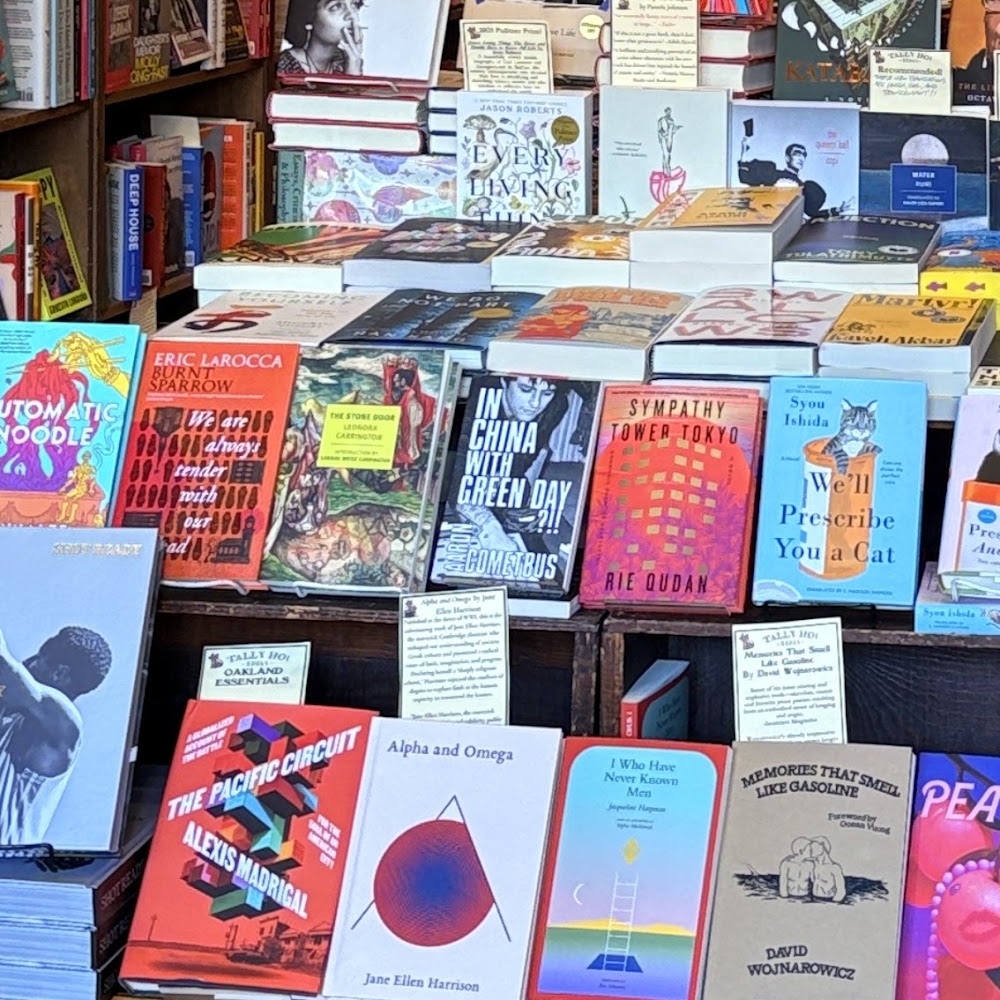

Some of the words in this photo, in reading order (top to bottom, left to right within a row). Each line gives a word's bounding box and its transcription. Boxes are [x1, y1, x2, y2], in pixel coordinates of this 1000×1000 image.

[480, 104, 513, 114] JASON
[516, 105, 562, 115] ROBERTS
[474, 146, 566, 166] EVERY
[912, 171, 936, 179] WATER
[129, 173, 140, 208] DEEP
[470, 178, 572, 199] LIVING
[128, 211, 140, 252] HOUSE
[154, 352, 195, 368] ERIC
[152, 365, 215, 380] BURNT
[149, 379, 234, 393] SPARROW
[475, 388, 504, 420] IN
[629, 398, 727, 419] SYMPATHY
[790, 396, 826, 413] Syou
[187, 410, 216, 428] We
[221, 415, 249, 429] are
[784, 413, 829, 428] Ishida
[469, 419, 538, 454] CHINA
[611, 423, 670, 442] TOWER
[681, 424, 739, 445] TOKYO
[205, 436, 262, 460] always
[174, 459, 228, 479] tender
[465, 451, 514, 478] WITH
[457, 476, 526, 509] GREEN
[530, 480, 572, 510] DAY
[808, 472, 871, 495] We'll
[179, 485, 218, 504] with
[183, 515, 213, 530] our
[779, 503, 896, 530] Prescribe
[445, 522, 475, 574] AARON
[774, 537, 821, 561] You
[830, 546, 843, 561] a
[854, 541, 897, 565] Cat
[465, 551, 559, 579] COMETBUS
[605, 572, 635, 592] RIE
[645, 572, 710, 594] QUDAN
[215, 676, 290, 687] ESSENTIALS
[224, 665, 284, 677] OAKLAND
[387, 740, 430, 757] Alpha
[432, 743, 460, 757] and
[464, 745, 514, 765] Omega
[167, 787, 208, 820] THE
[207, 761, 280, 805] PACIFIC
[280, 726, 362, 778] CIRCUIT
[619, 758, 646, 772] Who
[648, 761, 677, 773] Have
[603, 771, 637, 784] Never
[639, 774, 679, 787] Known
[741, 764, 818, 789] MEMORIES
[820, 766, 860, 784] THAT
[859, 775, 901, 798] SMELL
[756, 782, 788, 799] LIKE
[789, 780, 860, 798] GASOLINE
[626, 786, 652, 798] Men
[182, 820, 236, 872] ALEXIS
[236, 857, 309, 920] MADRIGAL
[766, 945, 808, 960] DAVID
[747, 962, 856, 981] WOJNAROWICZ
[363, 972, 391, 987] Jane
[393, 974, 426, 988] Ellen
[427, 977, 480, 993] Harrison
